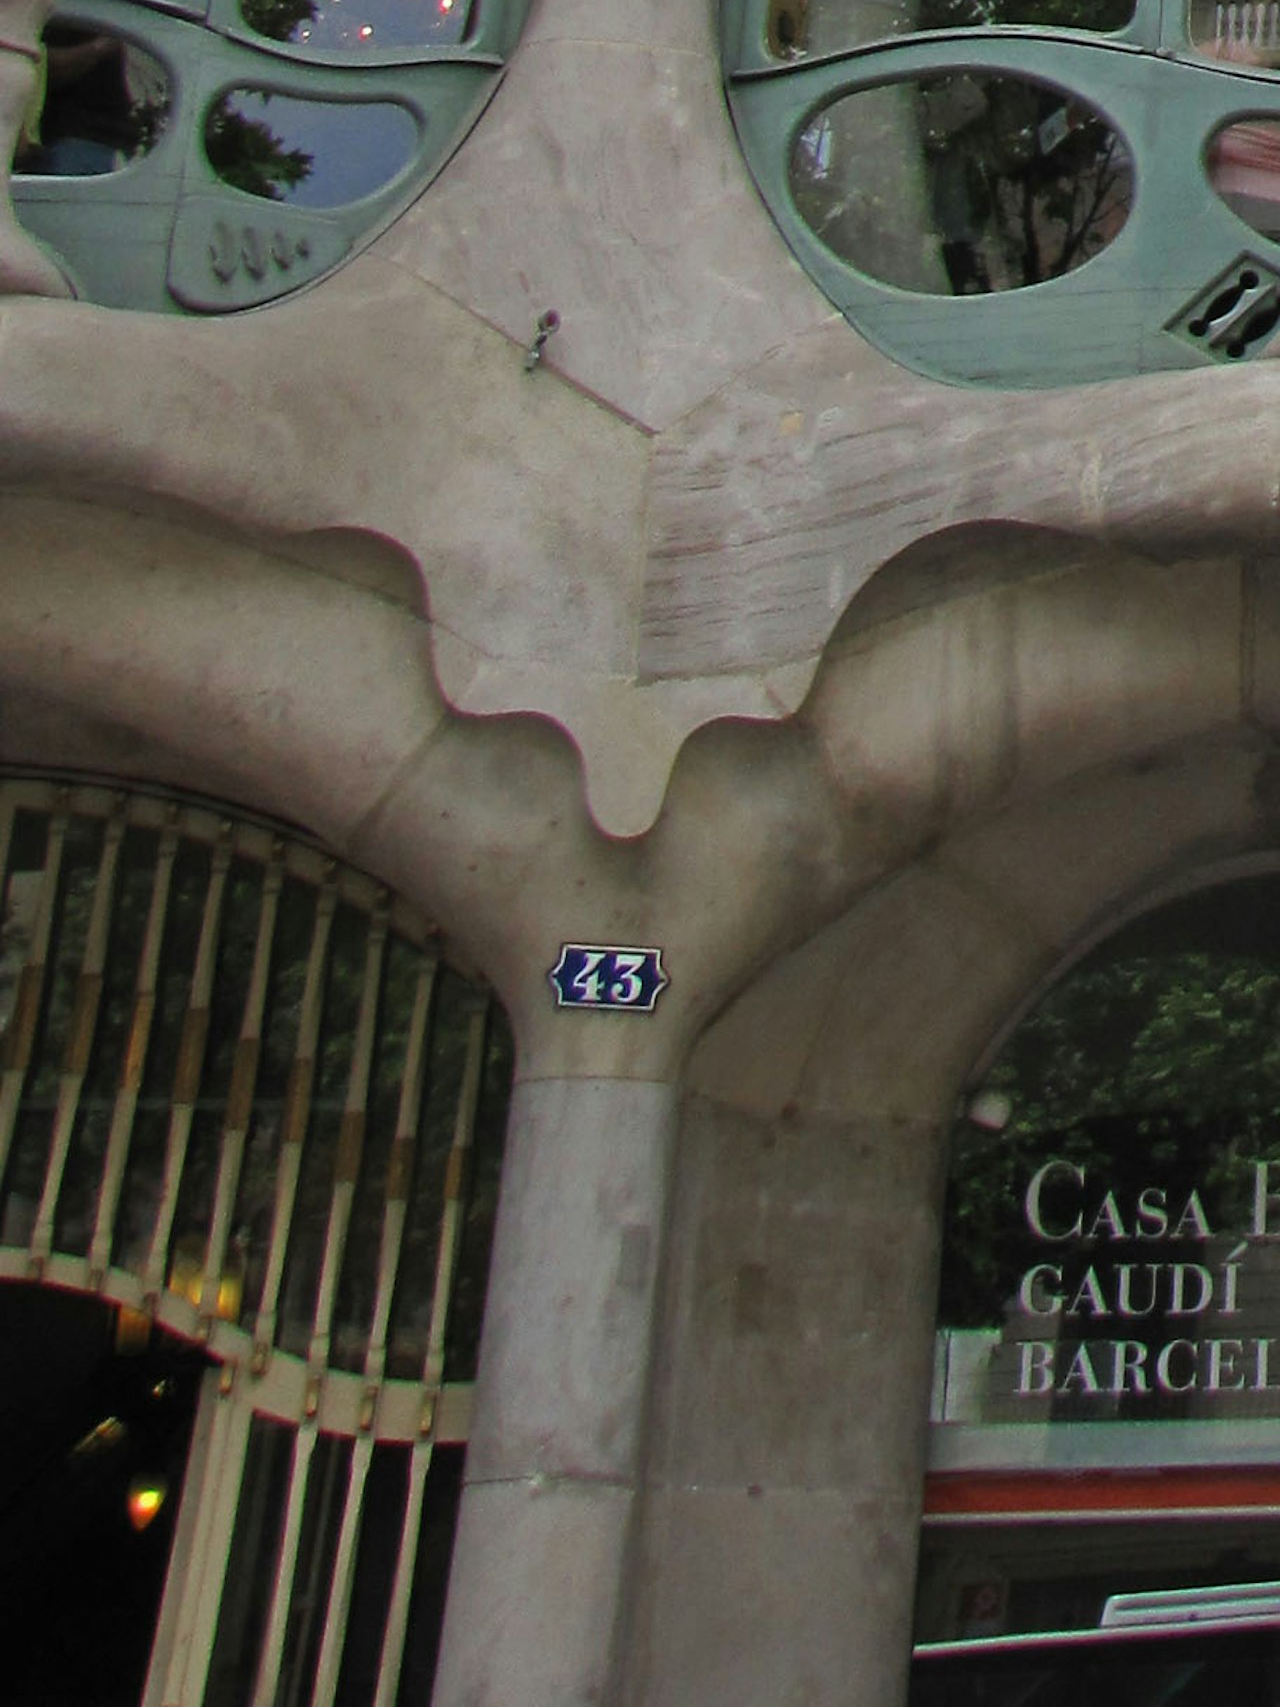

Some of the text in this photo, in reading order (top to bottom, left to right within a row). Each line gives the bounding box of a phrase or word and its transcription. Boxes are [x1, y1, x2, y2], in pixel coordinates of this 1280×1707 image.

[573, 952, 646, 1002] 43
[1025, 1159, 1215, 1240] CASA
[1019, 1241, 1248, 1316] GAUDÍ
